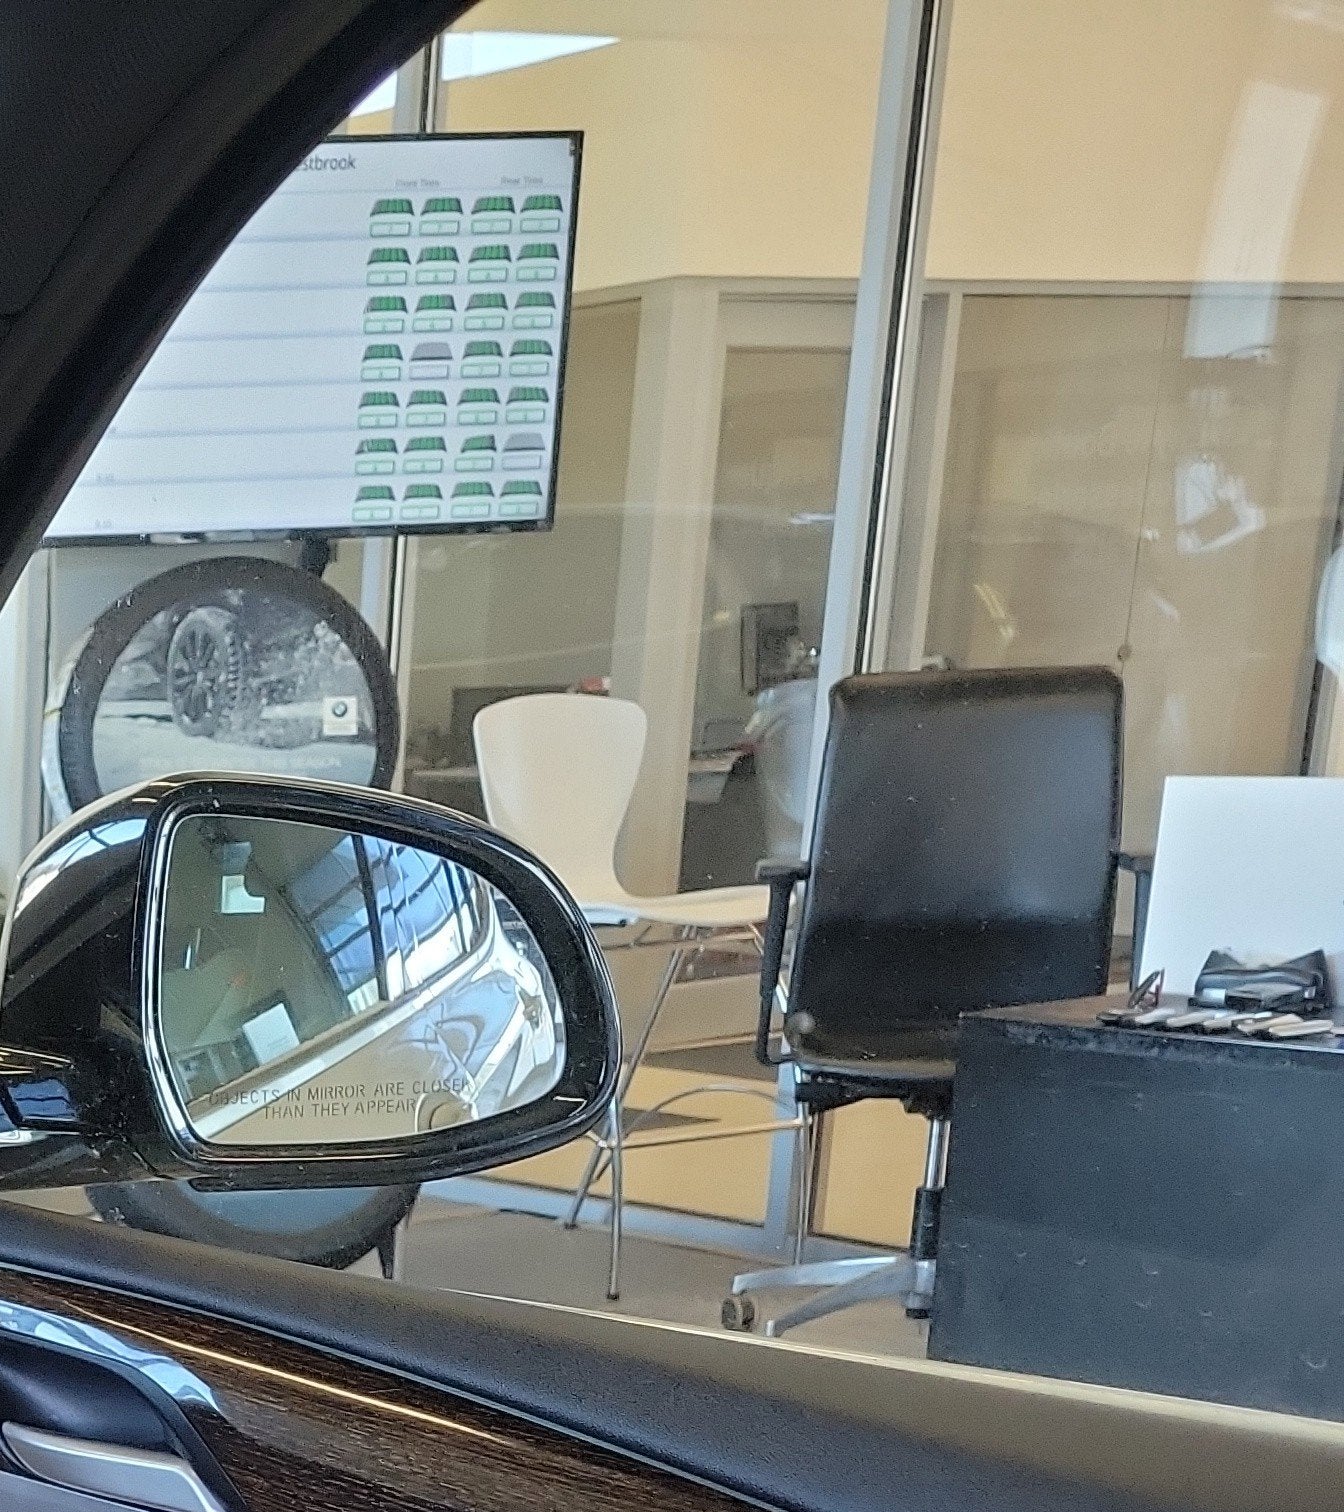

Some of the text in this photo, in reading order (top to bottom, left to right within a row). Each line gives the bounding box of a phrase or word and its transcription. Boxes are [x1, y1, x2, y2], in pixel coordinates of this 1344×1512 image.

[208, 1089, 280, 1106] OBJECTS
[287, 1088, 302, 1102] IN
[307, 1084, 365, 1100] MIRROR
[374, 1081, 405, 1096] ARE
[263, 1099, 416, 1119] THAN THEY APPEAR
